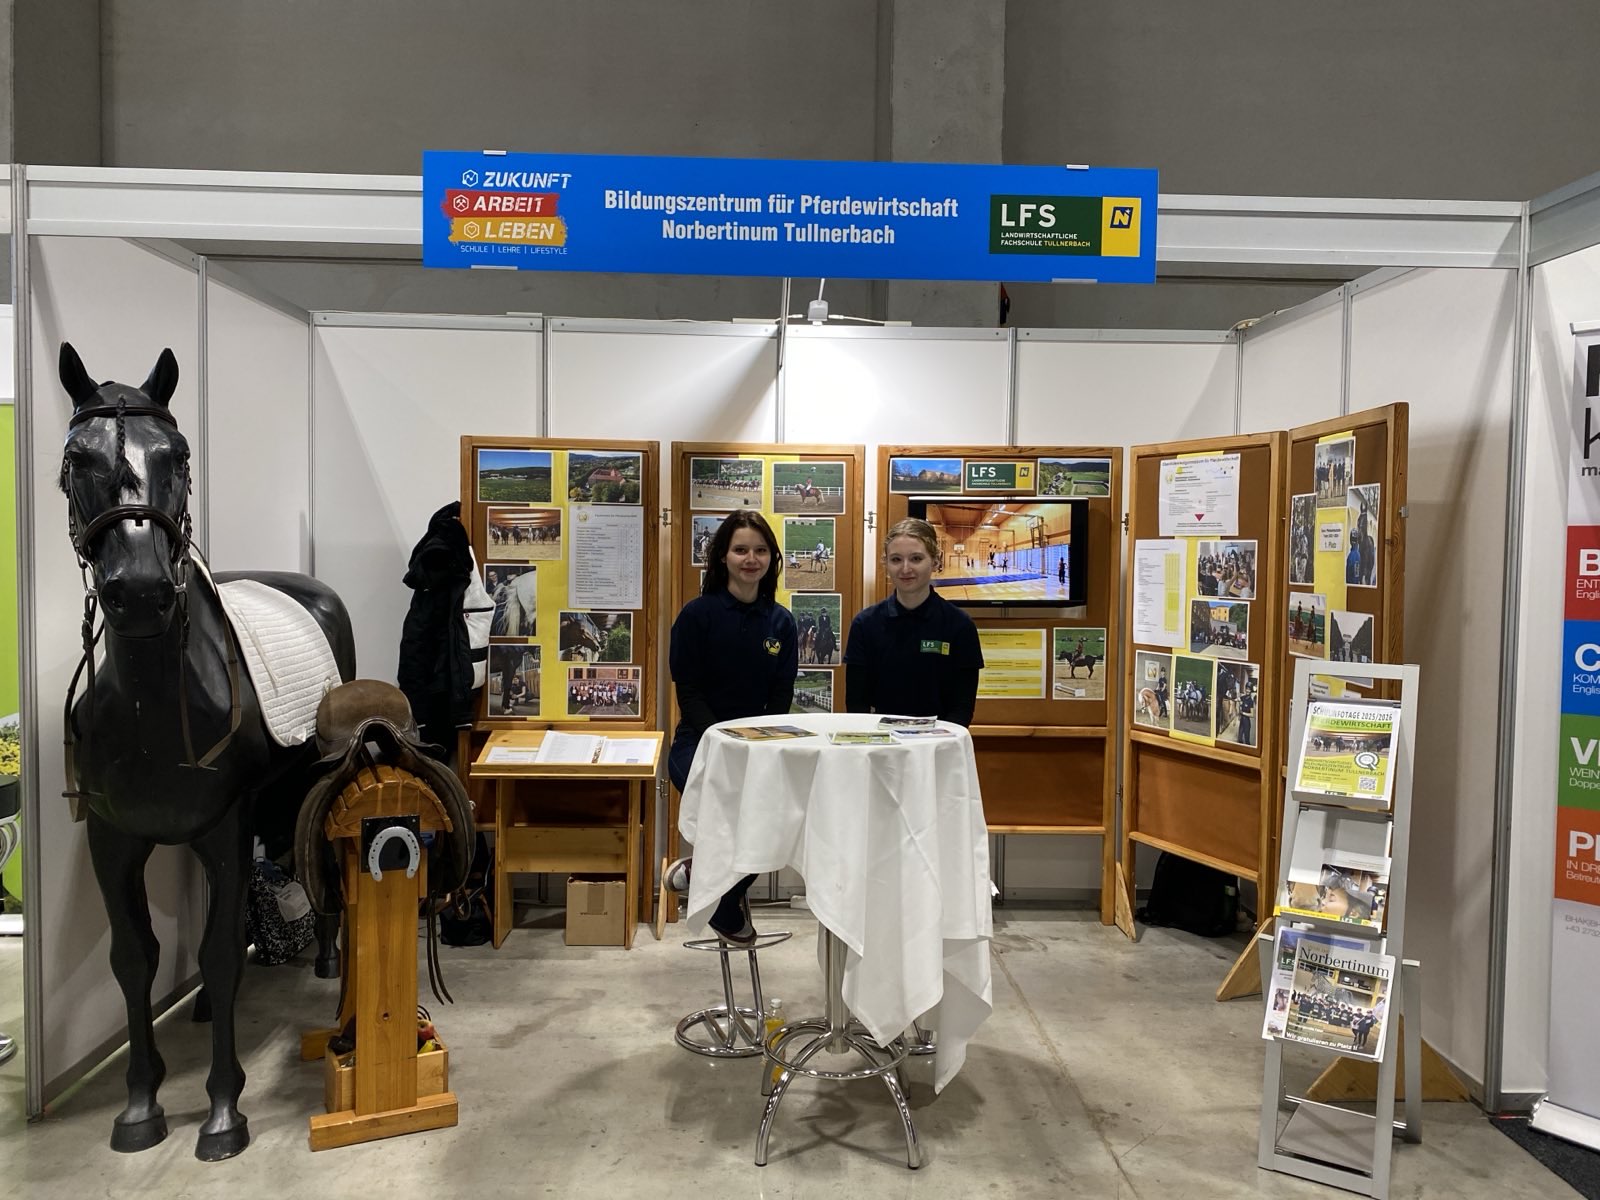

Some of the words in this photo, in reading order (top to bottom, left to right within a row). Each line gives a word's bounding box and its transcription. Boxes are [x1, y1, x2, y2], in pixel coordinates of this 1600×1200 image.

[483, 171, 572, 189] ZUKUNFT
[473, 195, 544, 213] ARBEIT
[604, 189, 761, 214] Bildungszentrum
[768, 194, 794, 214] für
[800, 195, 958, 217] Pferdewirtschaft
[1001, 203, 1056, 228] LFS
[484, 222, 555, 240] LEBEN
[662, 219, 778, 241] Norbertinum
[784, 222, 895, 244] Tullnerbach
[1001, 232, 1078, 240] LANDWIRTSCHAFTLICHE
[460, 245, 488, 253] SCHULE
[498, 246, 521, 254] LEHRE
[530, 247, 568, 255] LIFESTYLE
[1001, 239, 1042, 247] FACHSCHULE
[971, 466, 997, 478] LFS
[1361, 712, 1393, 722] 2025/2026
[1299, 946, 1390, 978] Norbertinum
[1286, 1032, 1296, 1040] Wir
